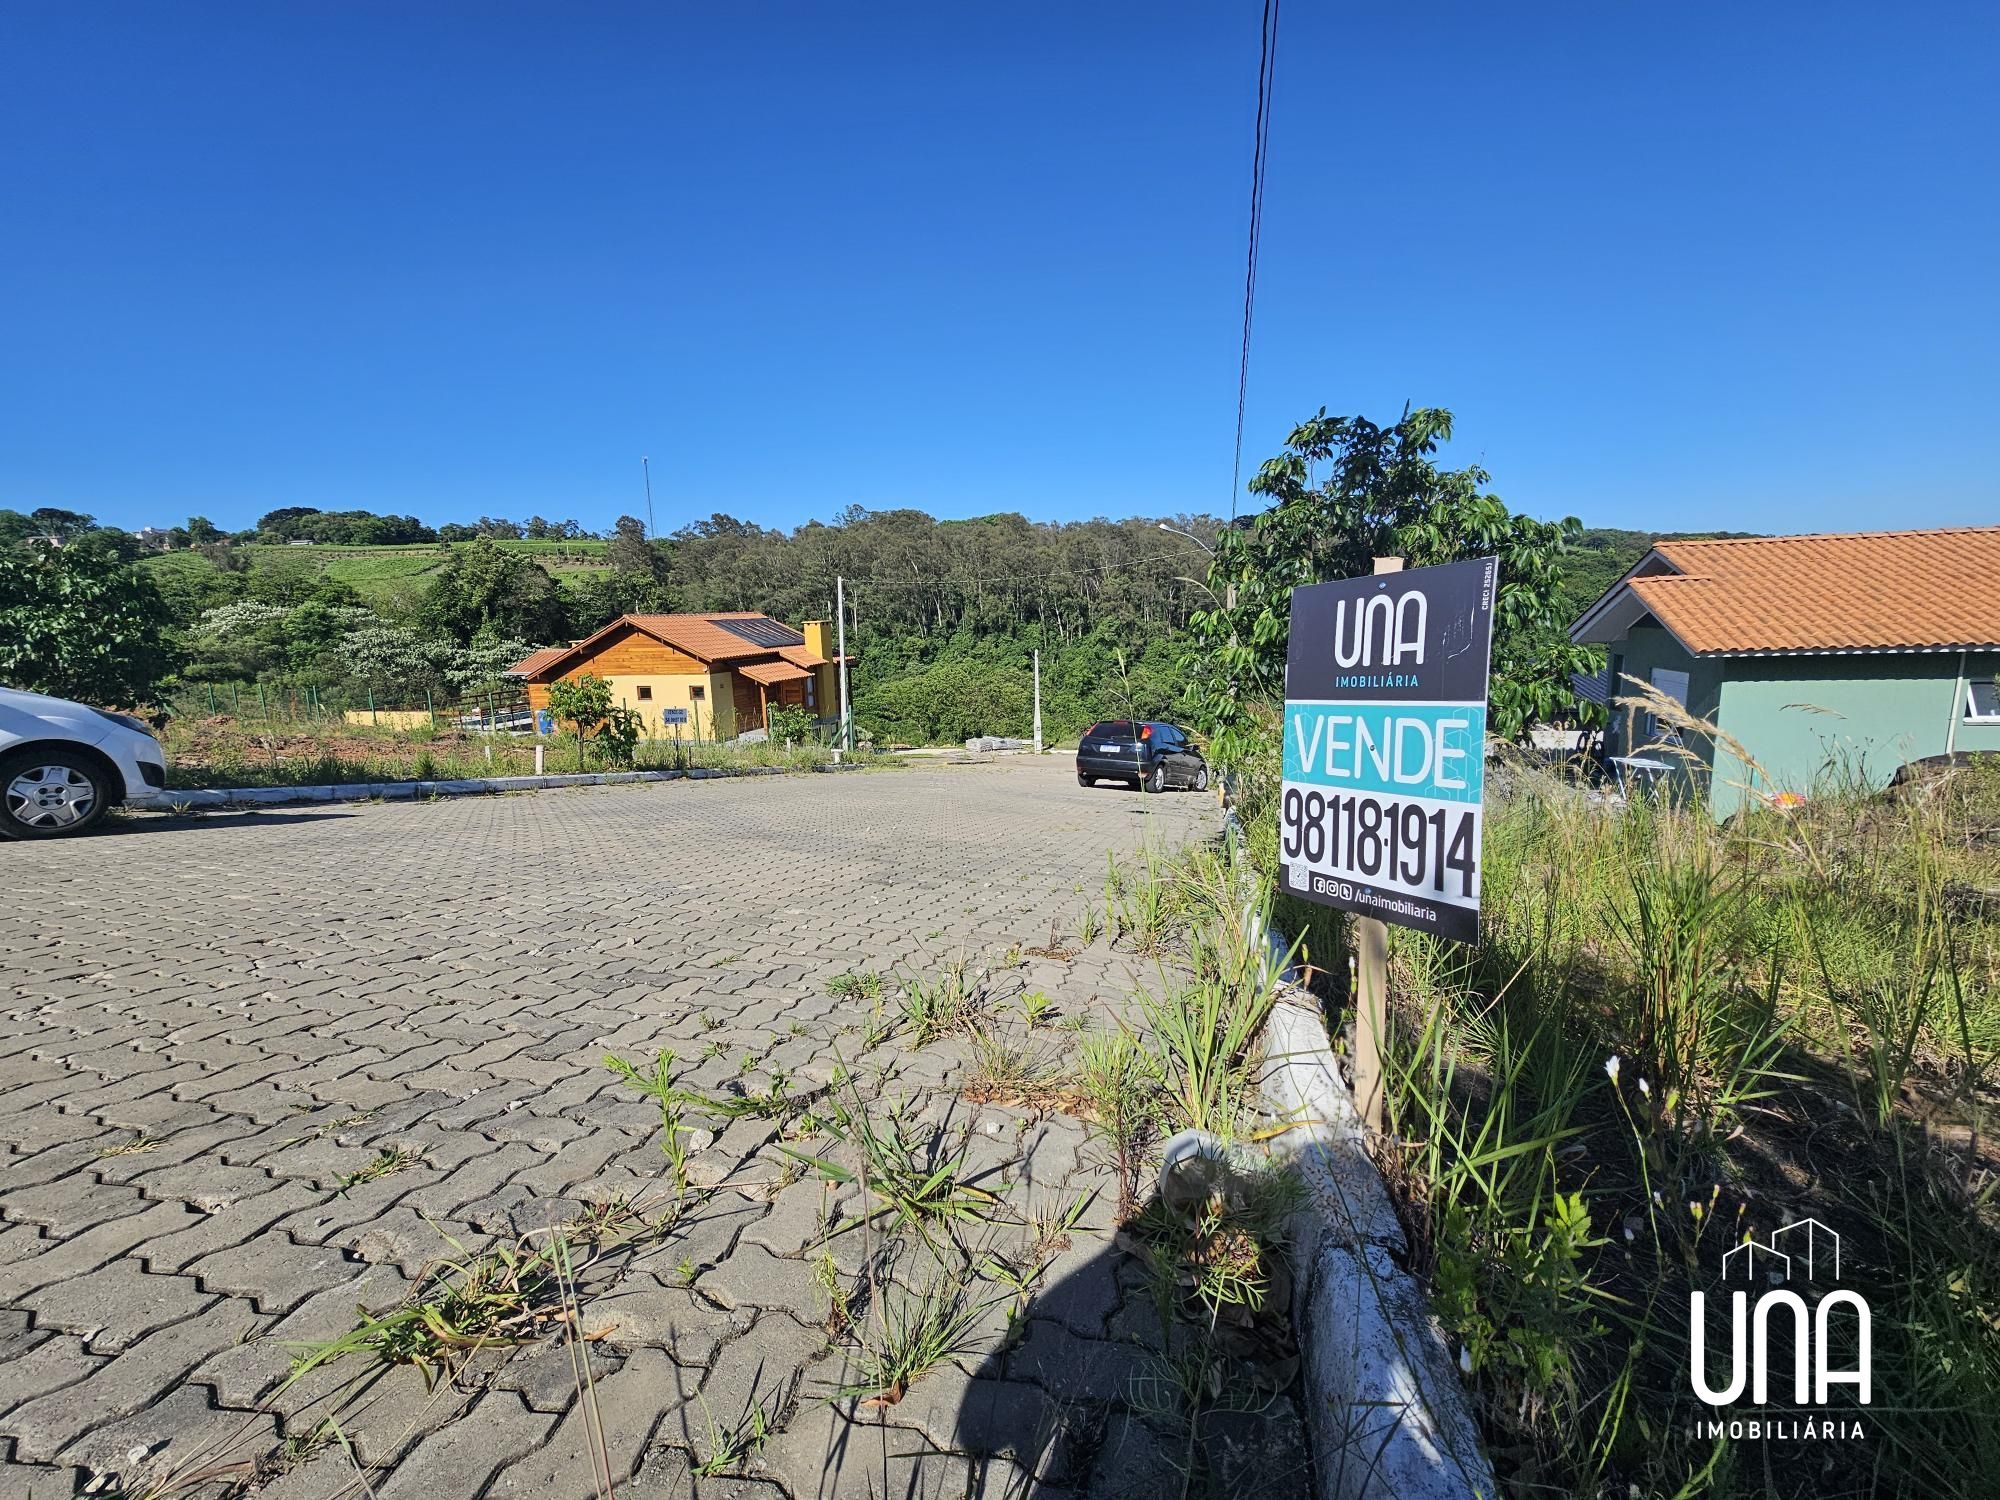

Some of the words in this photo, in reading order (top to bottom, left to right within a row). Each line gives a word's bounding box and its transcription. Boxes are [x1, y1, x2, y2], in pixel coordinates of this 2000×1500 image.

[1334, 590, 1428, 669] UNA
[1335, 671, 1419, 688] IMOBILIÁRIA
[1294, 713, 1469, 790] VENDE
[1283, 787, 1476, 899] 98118-1914
[1354, 889, 1437, 922] /unaimobiliaria
